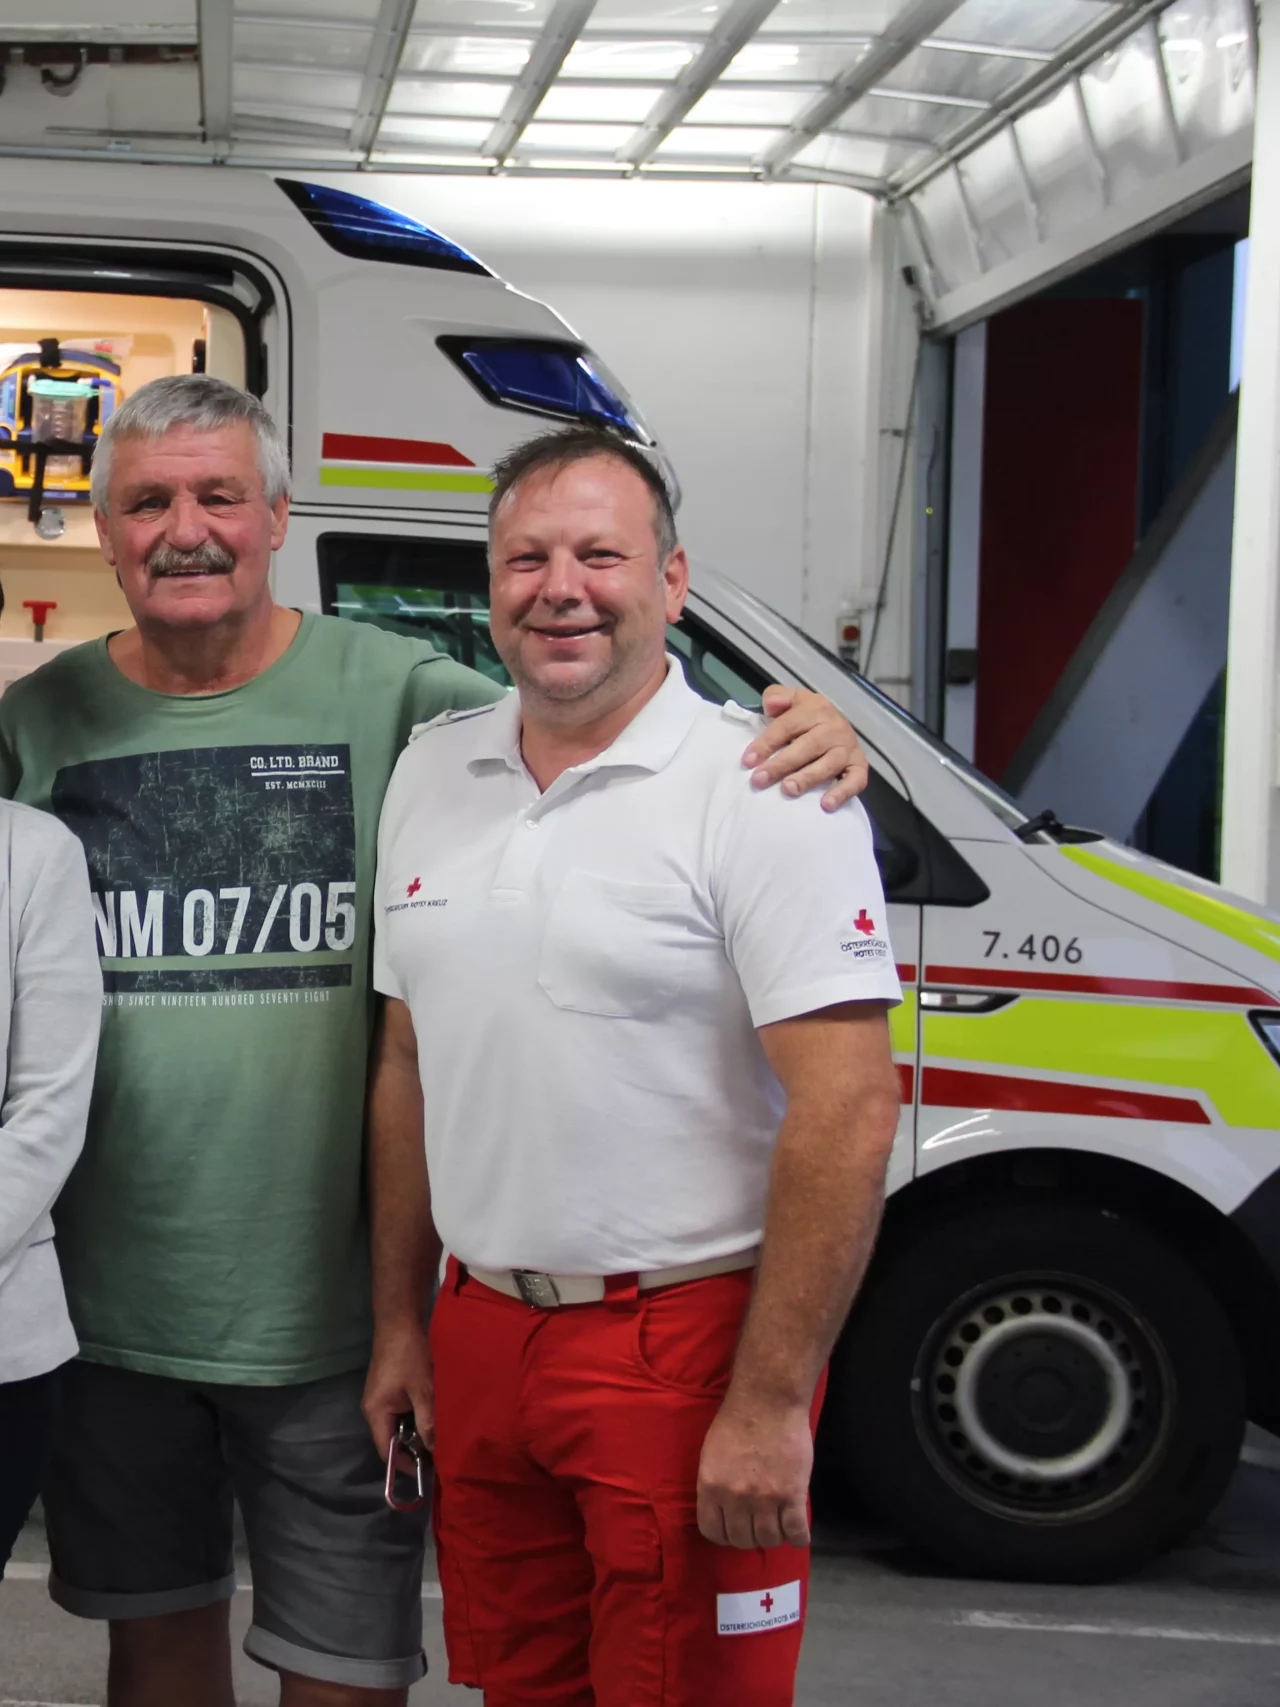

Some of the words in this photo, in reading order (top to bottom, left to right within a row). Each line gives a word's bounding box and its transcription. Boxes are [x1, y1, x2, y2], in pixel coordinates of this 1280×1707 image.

[250, 756, 267, 769] CO.
[269, 756, 295, 768] LTD.
[298, 755, 339, 768] BRAND
[265, 781, 284, 790] EST.
[182, 881, 356, 957] 07/05
[982, 930, 1083, 964] 7.406
[102, 994, 123, 1006] SHD
[129, 995, 155, 1006] SINCE
[161, 995, 206, 1007] NINETEEN
[212, 993, 254, 1006] HUNDRED
[260, 992, 299, 1004] SEVENTY
[304, 990, 330, 1002] EIGHT
